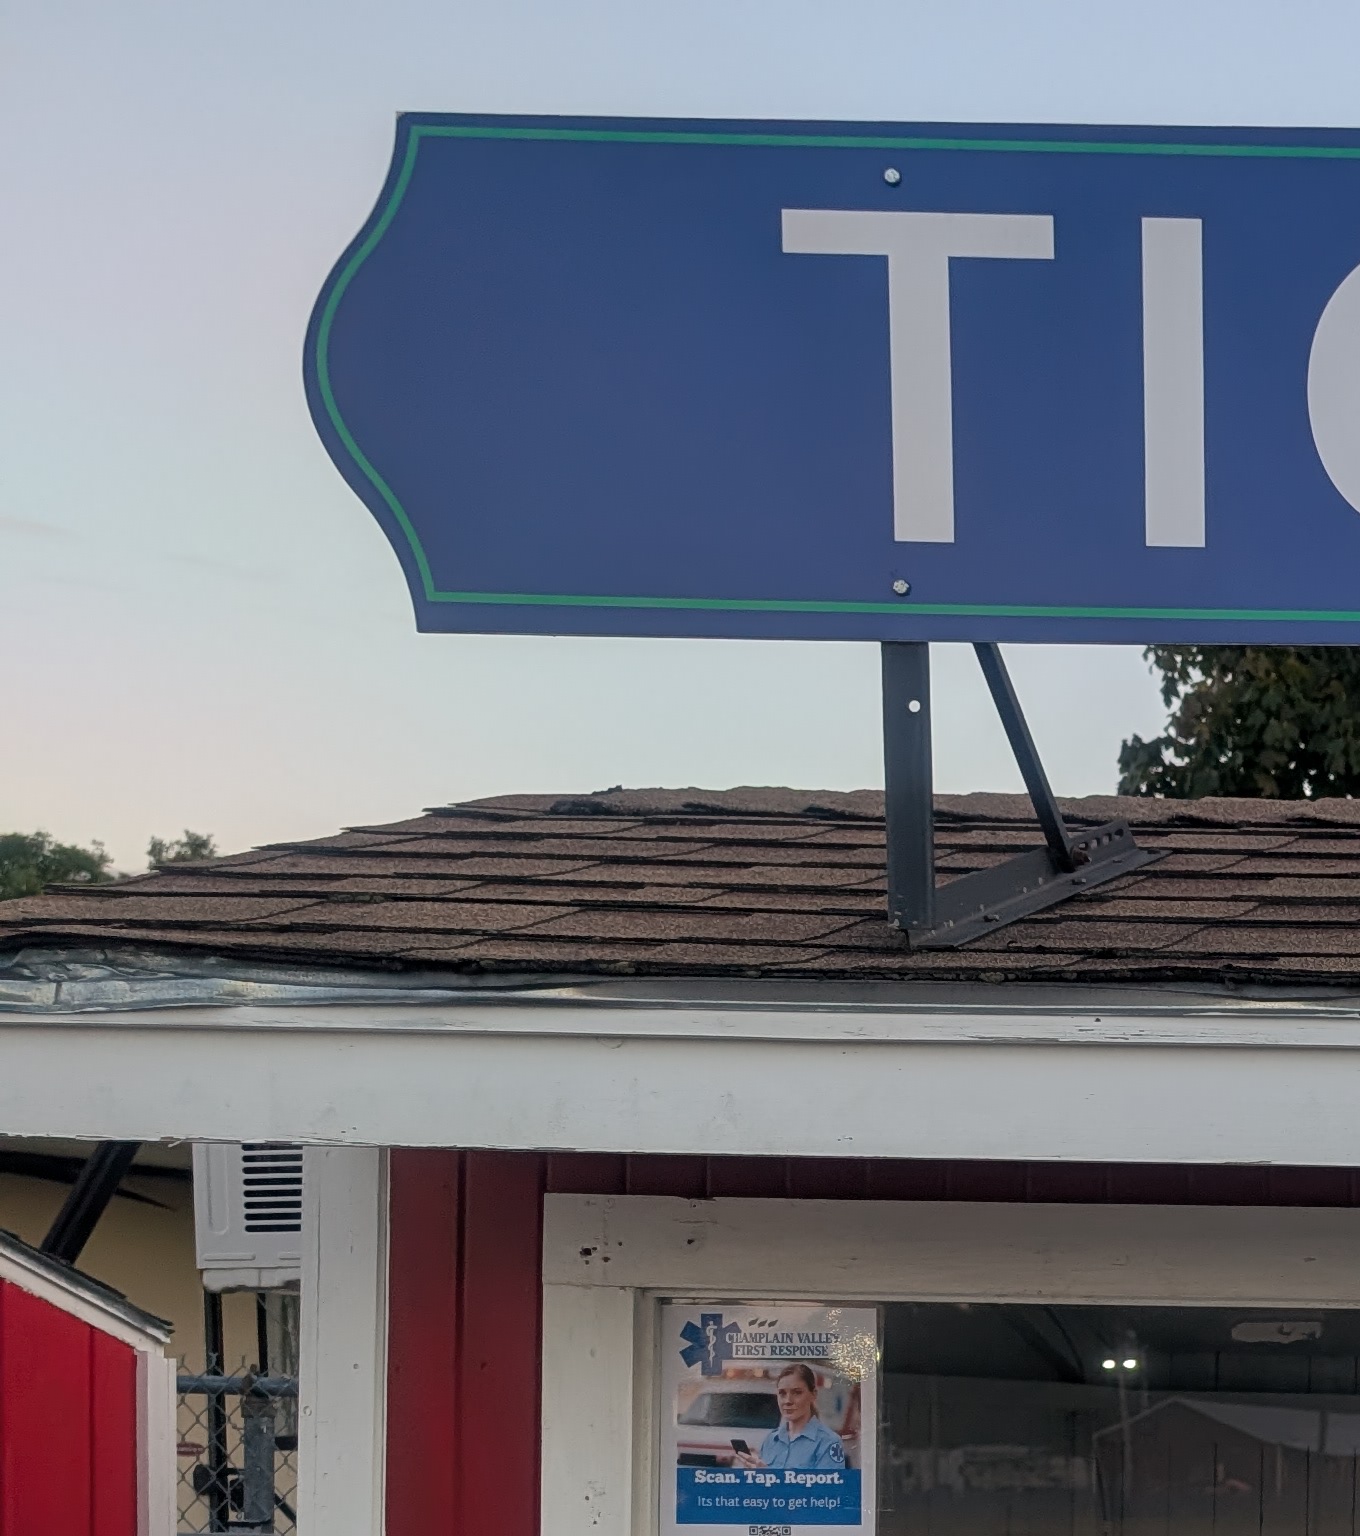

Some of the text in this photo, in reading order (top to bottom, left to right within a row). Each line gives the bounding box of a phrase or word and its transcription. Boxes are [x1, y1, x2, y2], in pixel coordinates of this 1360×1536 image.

[726, 1332, 840, 1344] CHAMPLAIN VALLEY
[735, 1345, 828, 1357] FIRST RESPONSE
[695, 1470, 844, 1488] Scan. Tap. Report.
[697, 1496, 841, 1510] Its that easy to get help!
